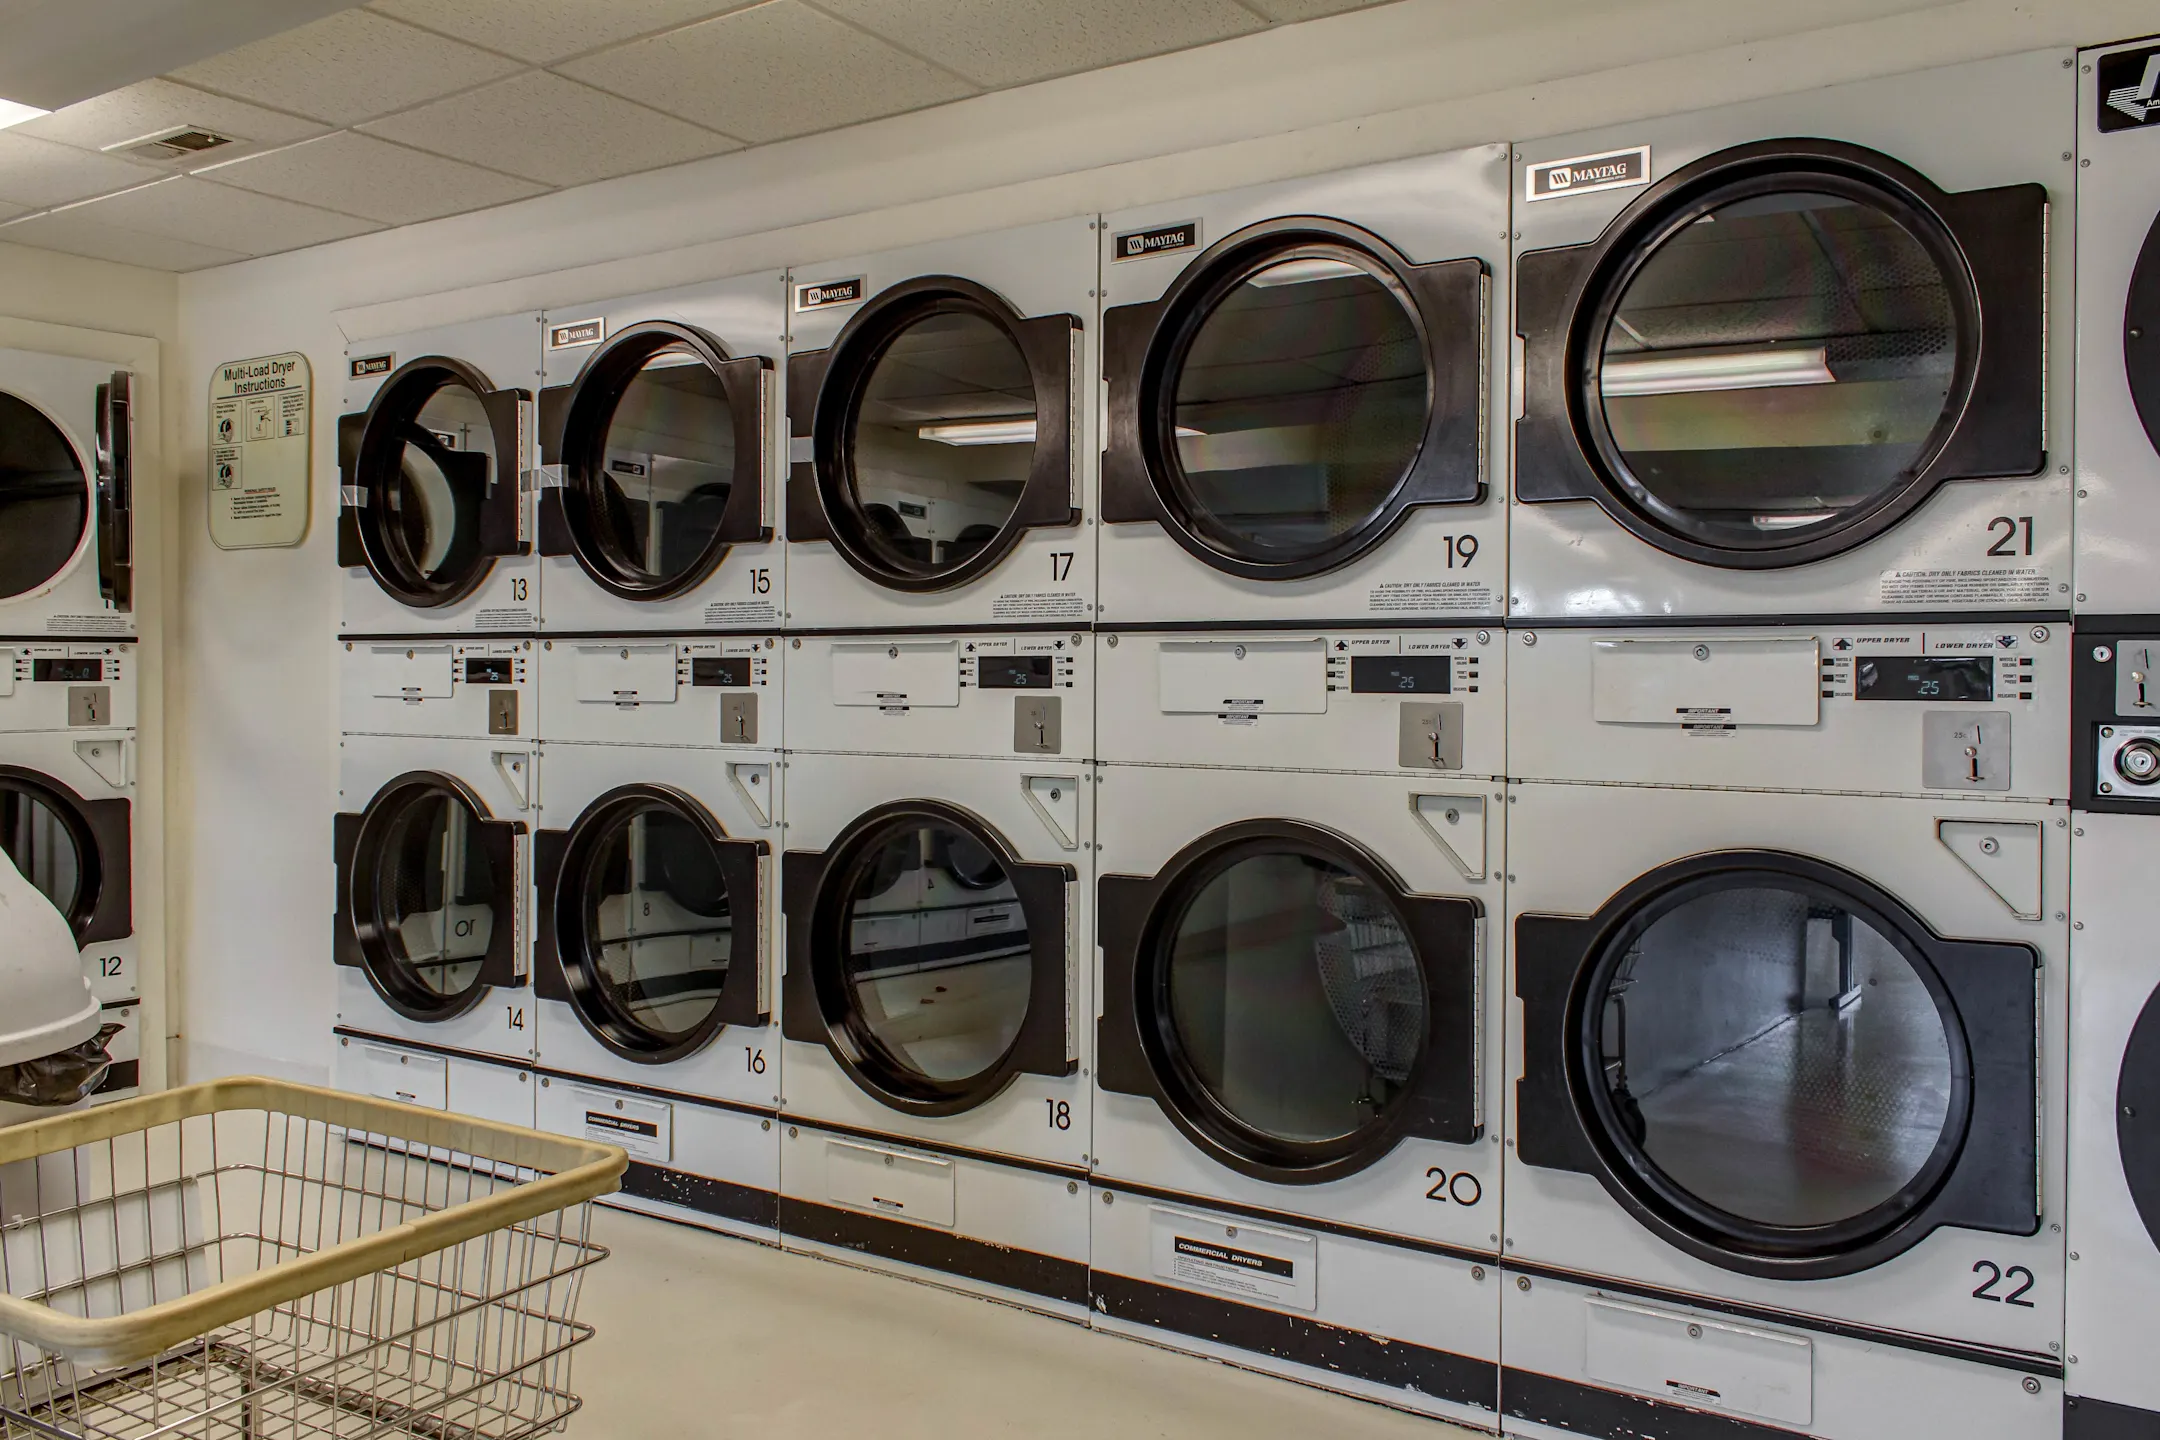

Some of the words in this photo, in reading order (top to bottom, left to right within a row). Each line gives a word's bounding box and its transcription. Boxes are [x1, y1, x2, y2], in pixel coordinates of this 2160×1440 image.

[1573, 163, 1626, 182] MAYTAG
[1145, 232, 1184, 248] MAYTAG
[822, 286, 852, 300] MAYTAG
[569, 328, 594, 338] MAYTAG
[225, 363, 269, 381] Multi-Load
[272, 362, 295, 375] Dryer
[366, 361, 386, 370] MAYTAG
[235, 378, 285, 394] Instructions
[1987, 516, 2032, 556] 21
[1444, 535, 1479, 568] 19
[1050, 552, 1074, 581] 17
[512, 578, 527, 601] 13
[750, 569, 770, 594] 15
[1398, 677, 1414, 688] .25
[1918, 681, 1939, 694] .25
[100, 956, 121, 977] 12
[507, 1006, 524, 1030] 14
[745, 1046, 766, 1074] 16
[588, 1116, 618, 1126] COMMERCIAL
[620, 1122, 639, 1130] DRYERS
[1046, 1099, 1071, 1130] 18
[1426, 1167, 1482, 1206] 20
[1179, 1243, 1228, 1259] COMMERCIAL
[1232, 1255, 1262, 1266] DRYERS
[1973, 1260, 2034, 1308] 22
